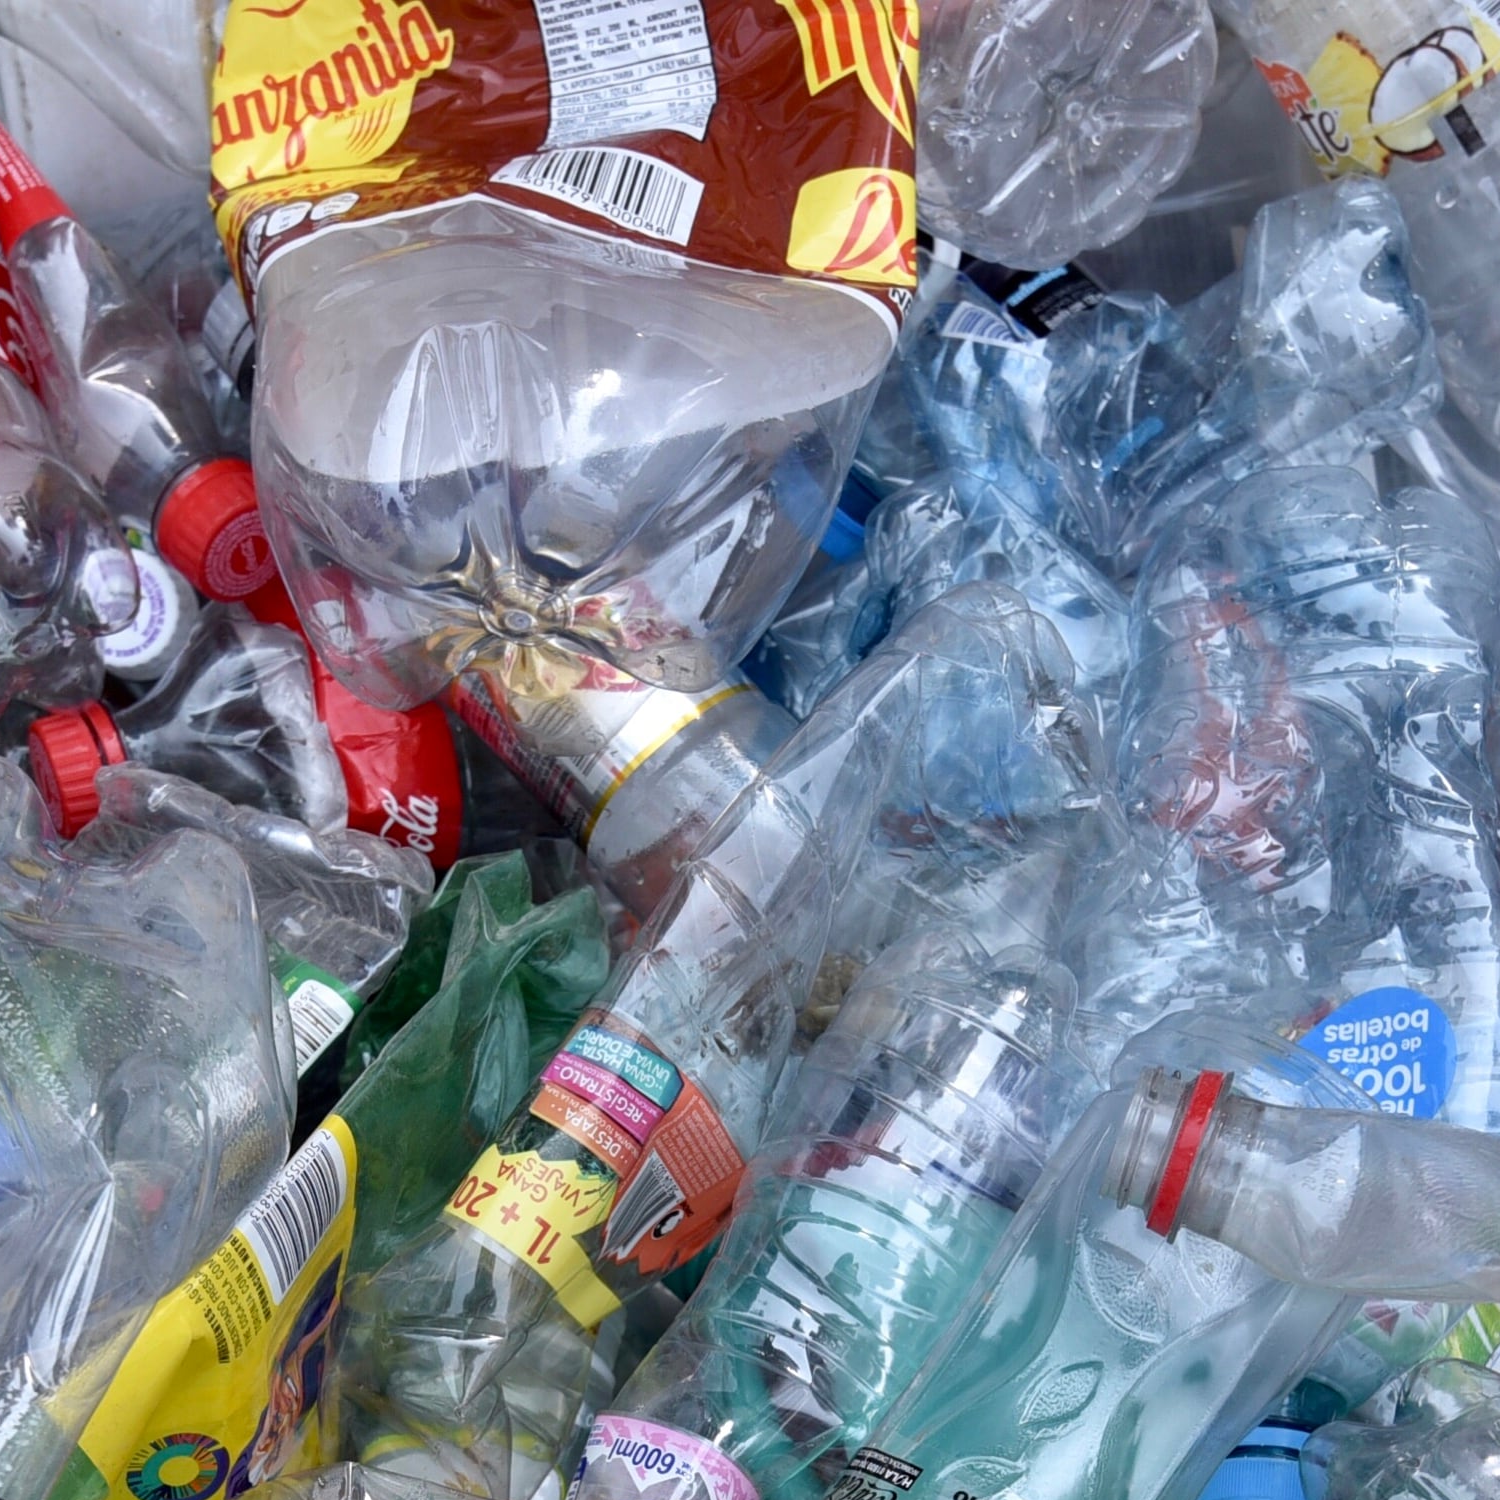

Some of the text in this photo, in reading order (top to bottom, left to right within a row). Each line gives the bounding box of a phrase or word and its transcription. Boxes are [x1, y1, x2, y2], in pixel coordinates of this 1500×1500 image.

[547, 32, 579, 46] SERVING
[585, 27, 600, 38] SIZE
[646, 9, 677, 22] AMOUNT
[684, 4, 699, 14] PER
[548, 43, 580, 57] SERVING
[651, 30, 683, 44] SERVING
[688, 25, 702, 35] PER
[212, 0, 449, 167] anzanita
[519, 174, 592, 206] 501479
[576, 1018, 672, 1084] UN VIAJE DIARIO
[1324, 1008, 1428, 1042] botellas
[1326, 1036, 1421, 1063] de otras
[579, 1036, 657, 1088] GANA HASTA
[1354, 1061, 1425, 1096] 100
[559, 1106, 624, 1158] DESTAPA
[248, 1136, 322, 1225] 501055 304813
[492, 1157, 551, 1206] GANA
[520, 1150, 586, 1206] VIAJES
[514, 1214, 568, 1268] 1L
[181, 1280, 204, 1305] AGU
[215, 1245, 273, 1334] TORONJA CON JUGO
[224, 1232, 287, 1321] INFORMACIÓN NUTRI
[202, 1299, 257, 1358] CONCENTRADO
[209, 1277, 259, 1346] THE COCA-COLA
[605, 1435, 676, 1475] 600ml
